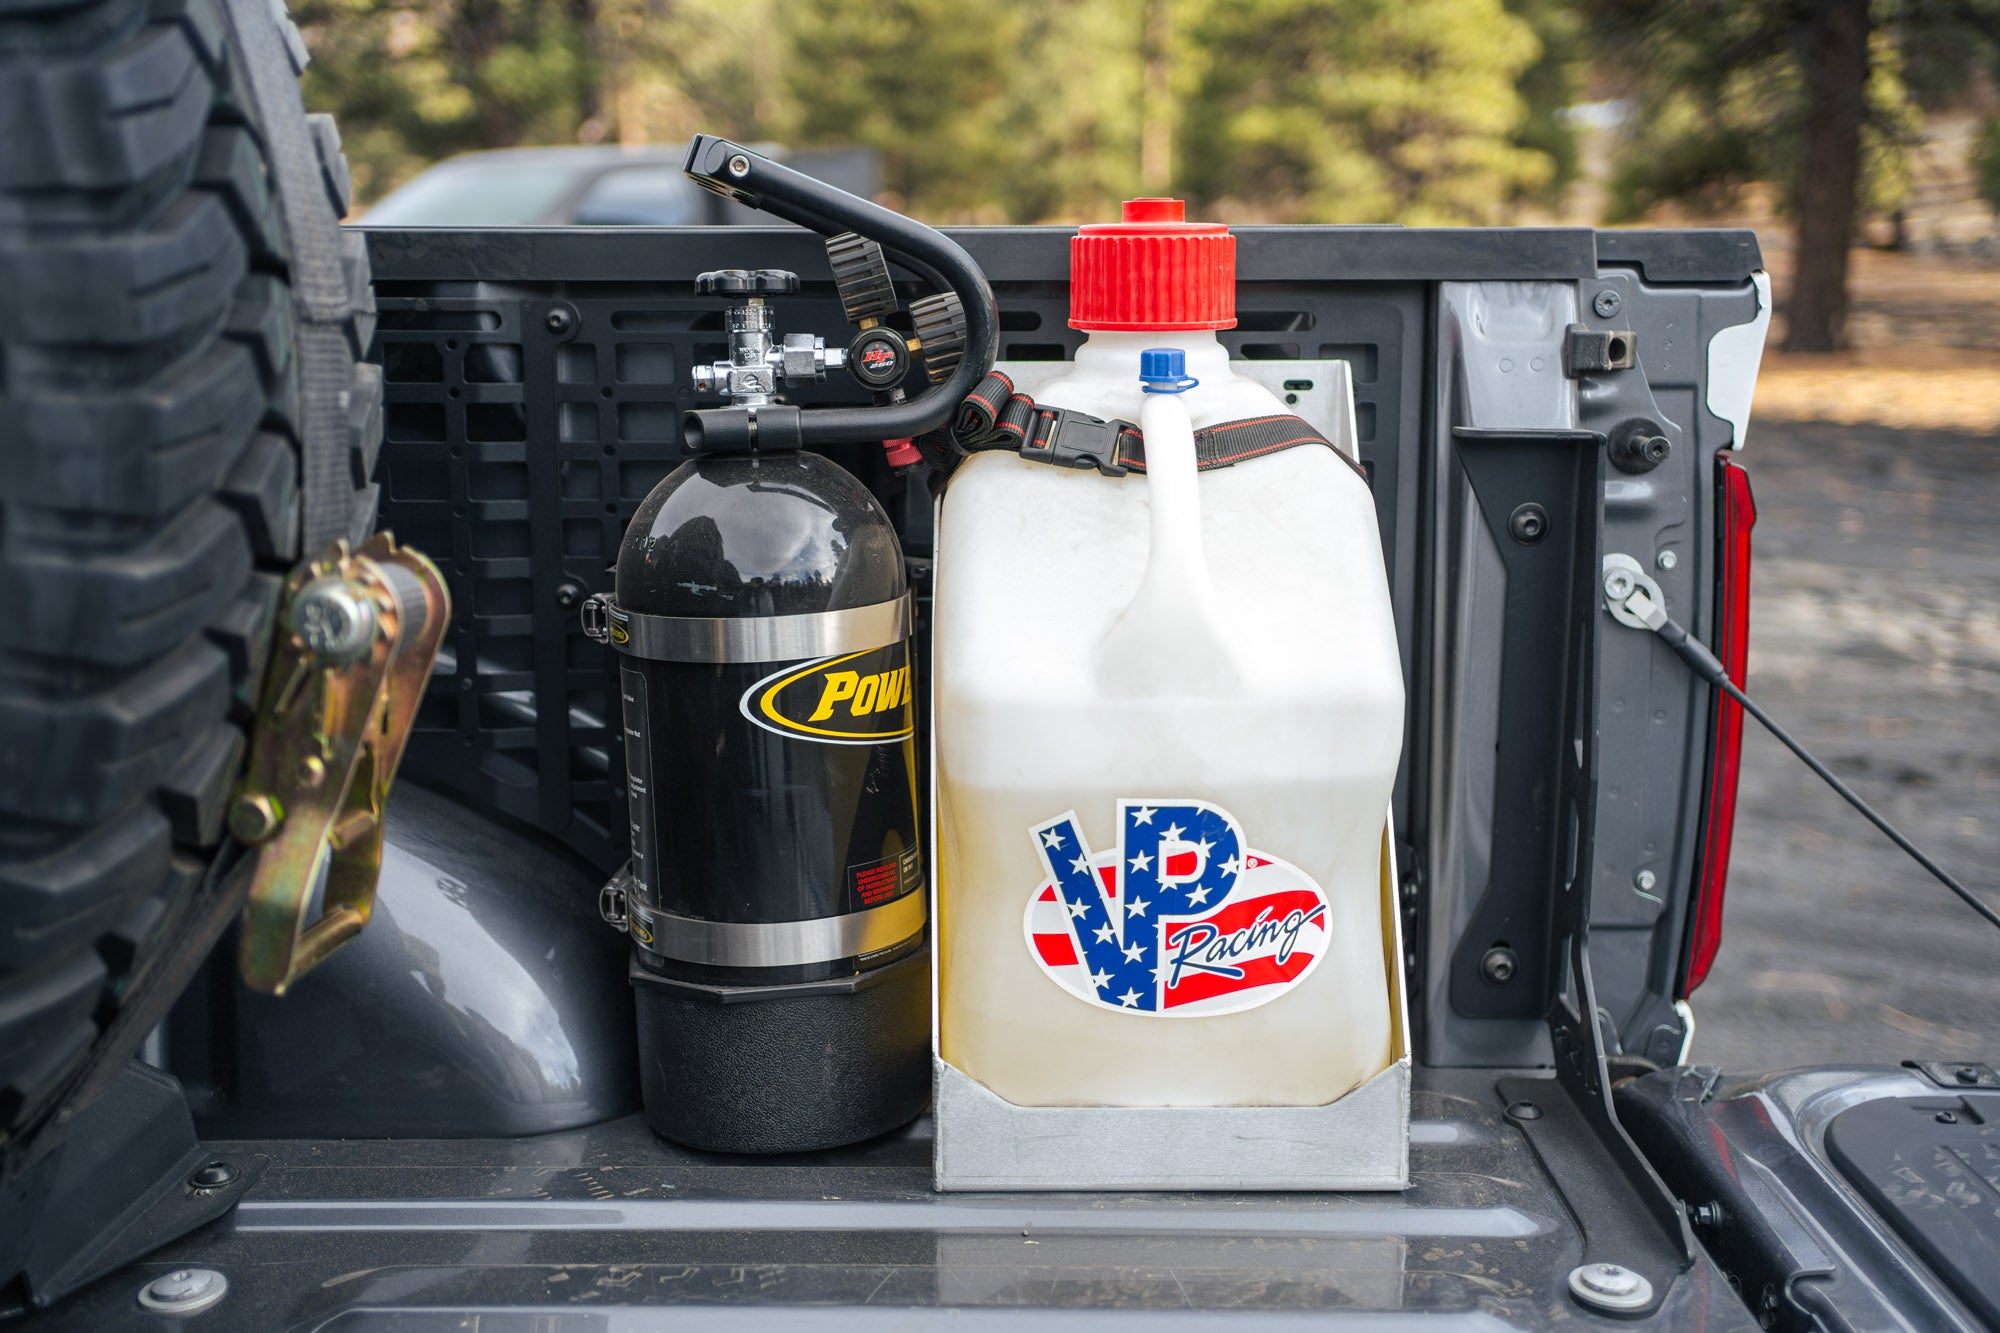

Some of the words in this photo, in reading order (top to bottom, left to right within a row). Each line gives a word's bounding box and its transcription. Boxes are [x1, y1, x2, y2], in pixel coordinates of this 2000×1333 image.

[870, 361, 894, 369] 250
[1036, 804, 1241, 1013] VP
[1166, 904, 1327, 988] Racing
